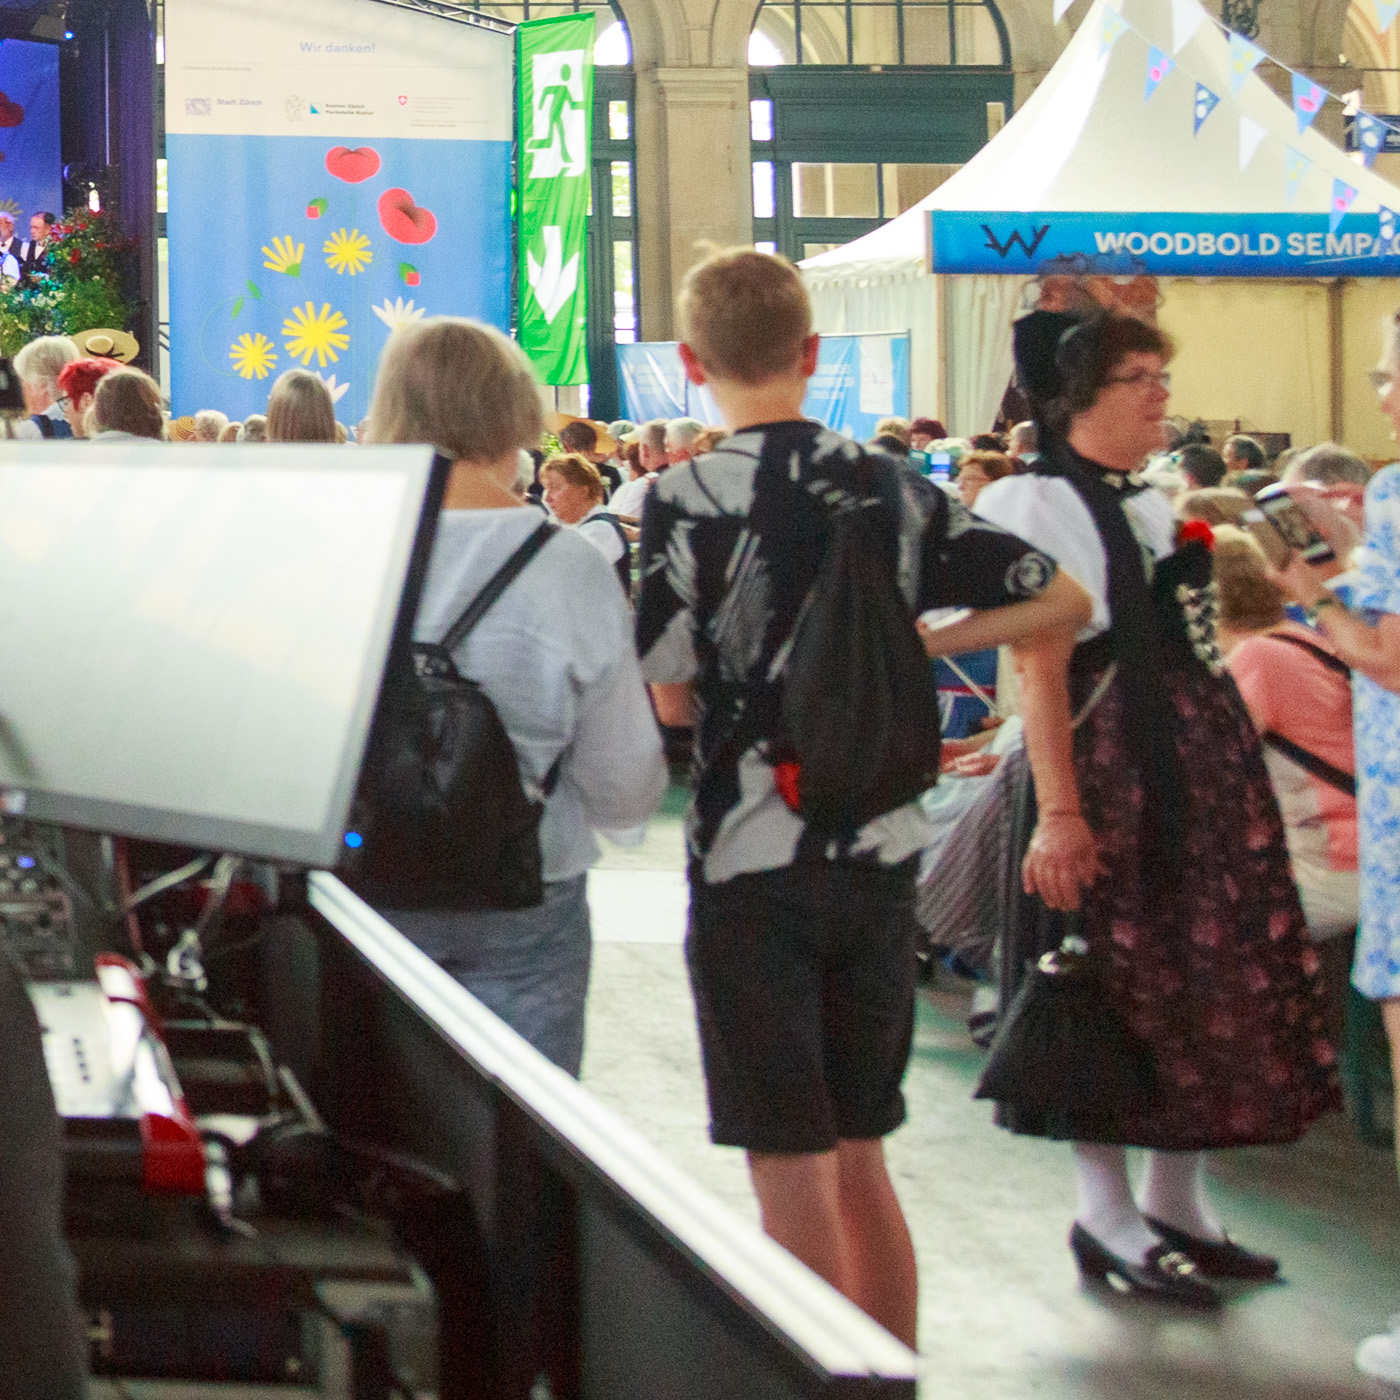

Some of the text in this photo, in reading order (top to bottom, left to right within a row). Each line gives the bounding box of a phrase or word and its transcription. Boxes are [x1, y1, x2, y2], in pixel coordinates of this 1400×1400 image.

[299, 41, 375, 54] Wir danken!
[1094, 231, 1280, 257] WOODBOLD
